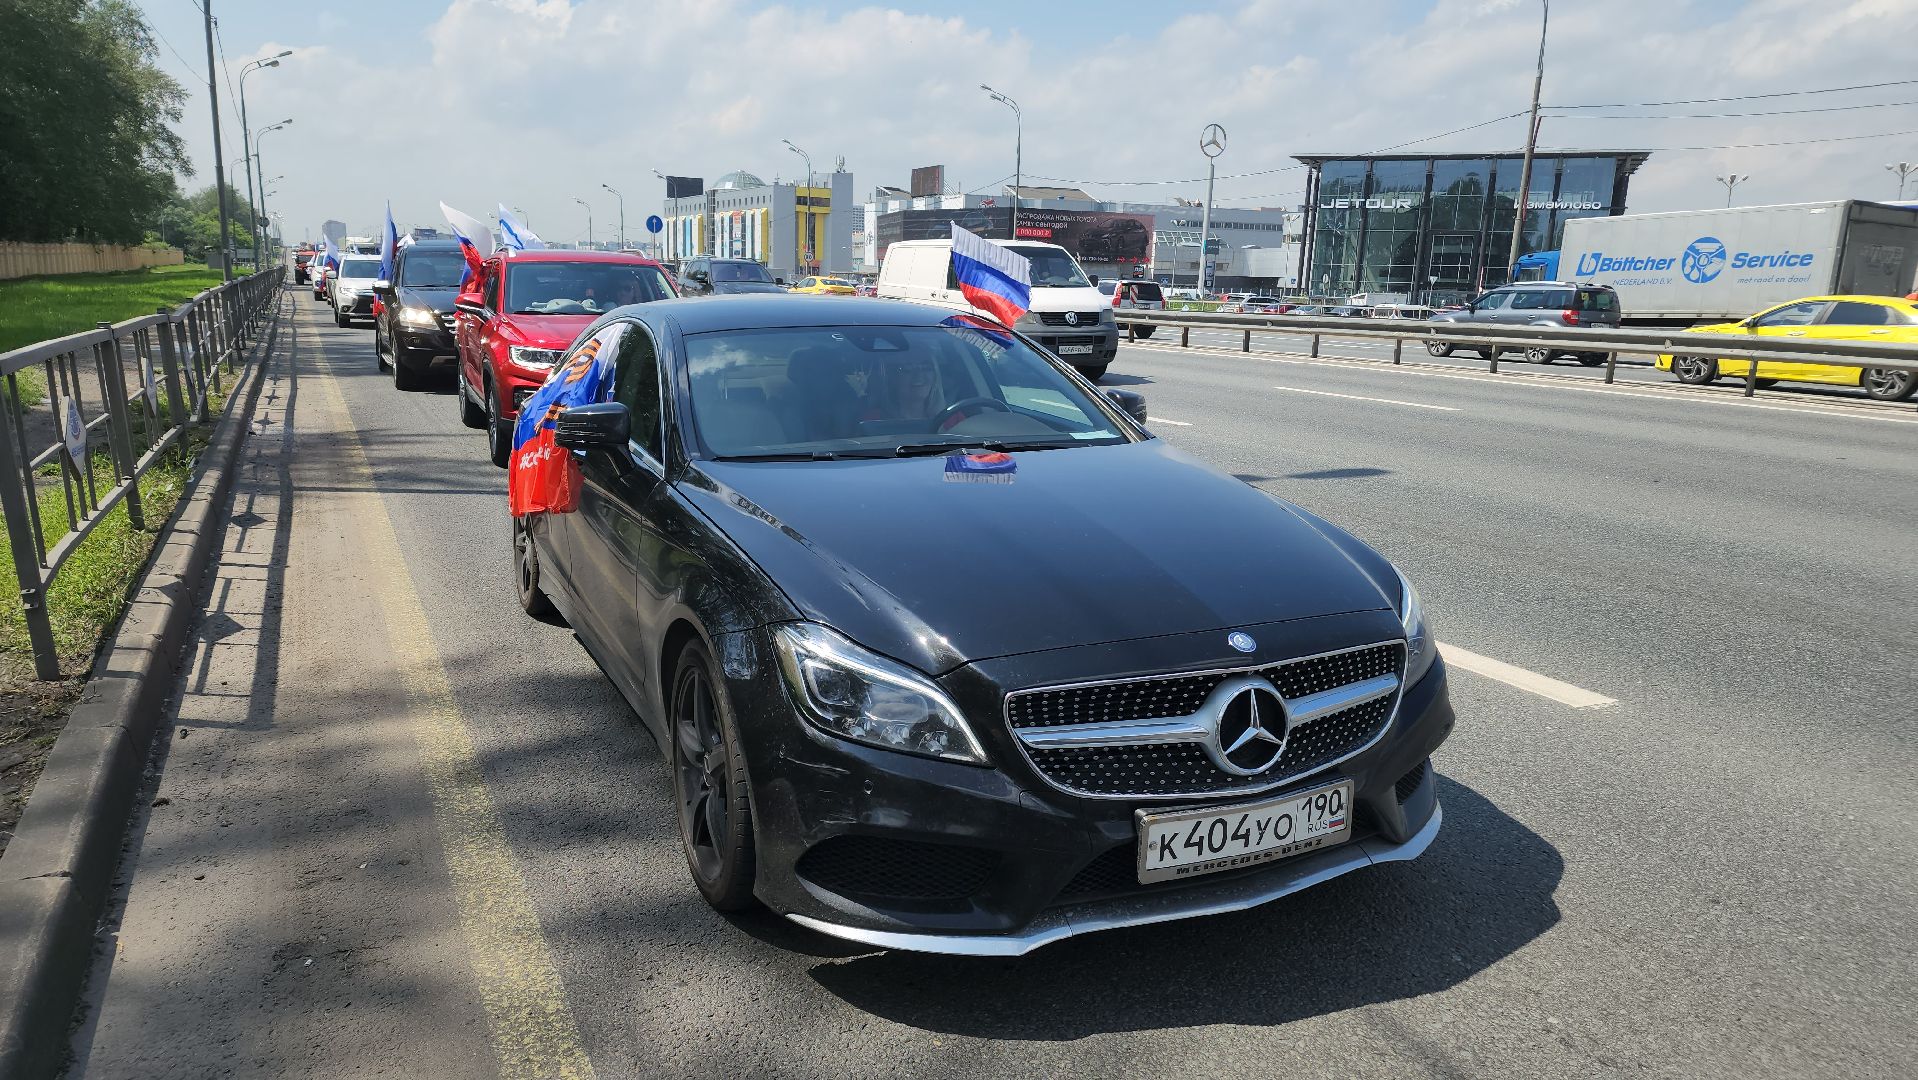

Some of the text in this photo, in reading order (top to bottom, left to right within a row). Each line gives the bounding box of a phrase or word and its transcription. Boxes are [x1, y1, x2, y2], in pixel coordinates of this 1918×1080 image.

[1320, 198, 1411, 209] JETOUR
[1599, 250, 1814, 272] Böttcher Service
[1612, 277, 1658, 286] NEDERLAND
[1159, 789, 1342, 862] К404УО 190
[1307, 820, 1328, 834] RUS
